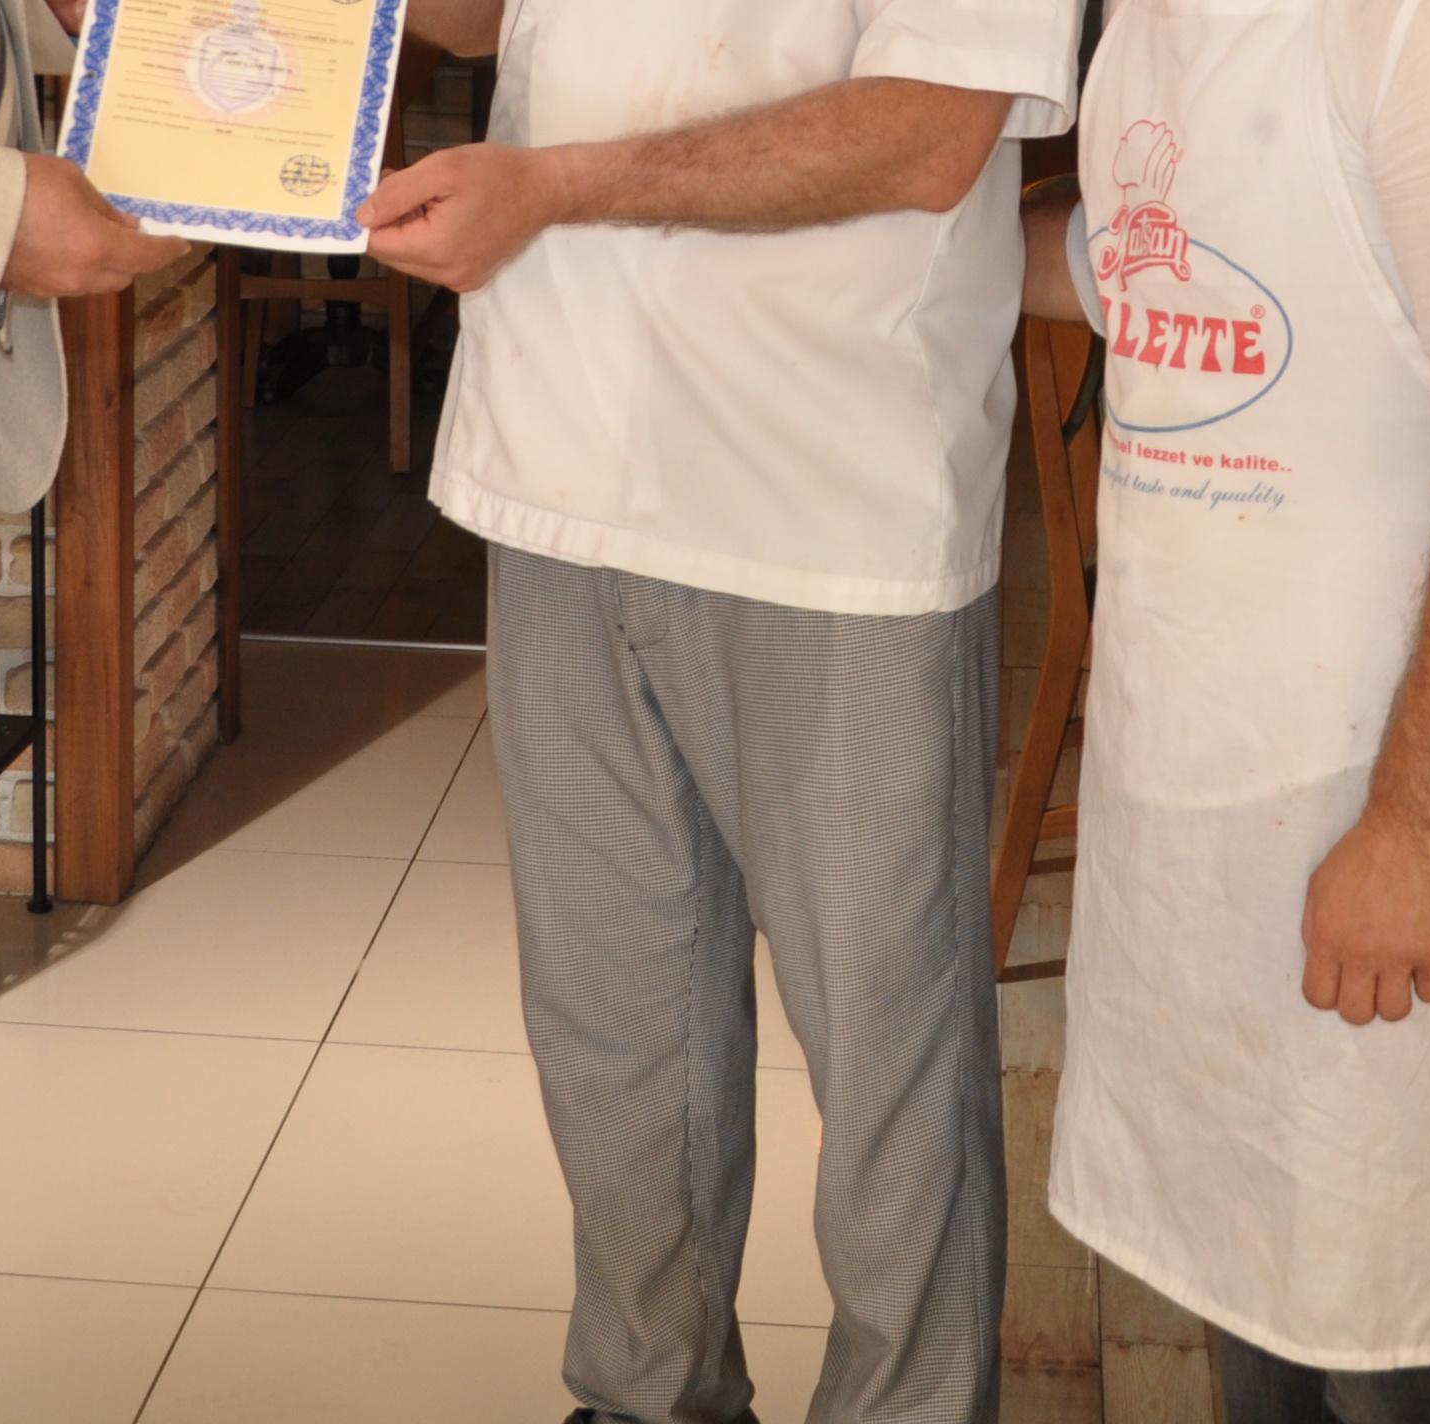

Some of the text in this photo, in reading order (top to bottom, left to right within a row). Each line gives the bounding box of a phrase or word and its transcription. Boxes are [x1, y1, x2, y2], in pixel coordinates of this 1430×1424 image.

[1137, 442, 1186, 465] lezzet
[1192, 454, 1214, 468] ve
[1170, 479, 1211, 501] and
